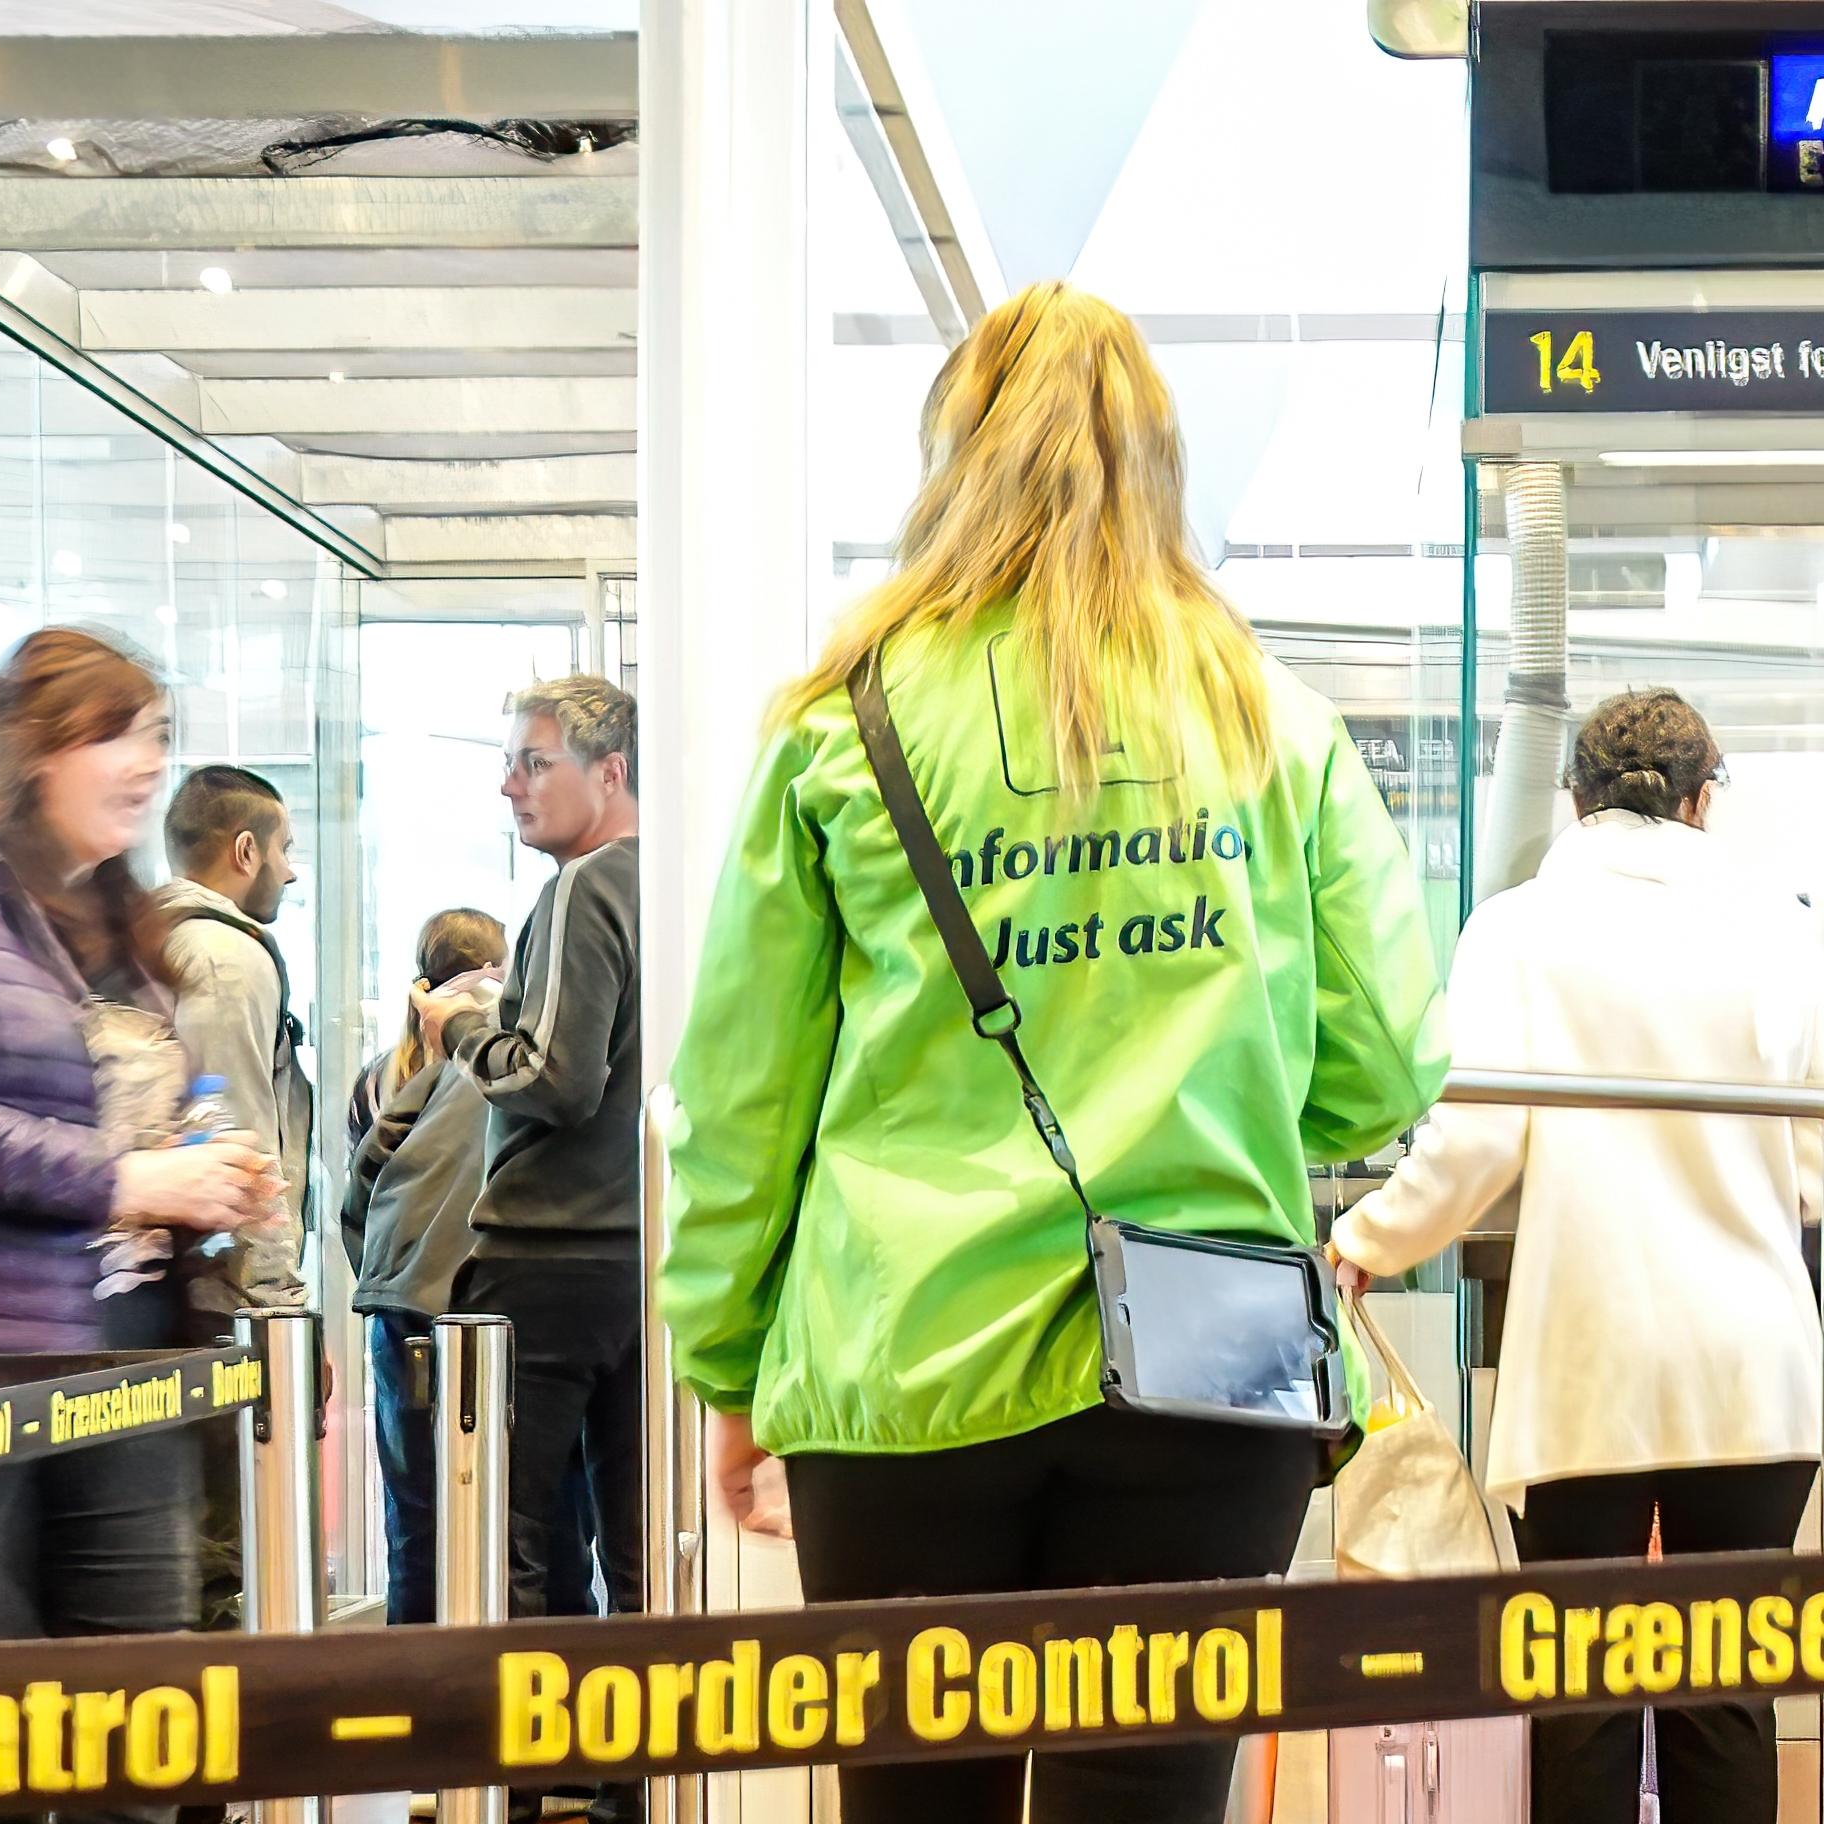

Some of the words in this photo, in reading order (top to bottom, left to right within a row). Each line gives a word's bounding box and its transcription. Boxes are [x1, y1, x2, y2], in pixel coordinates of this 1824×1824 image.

[1529, 330, 1602, 394] 14
[1635, 339, 1785, 387] Venligst
[948, 806, 1252, 888] nformatio
[991, 911, 1104, 970] Just
[1117, 894, 1227, 956] ask
[50, 1368, 182, 1445] Grænsekontrol
[497, 1636, 882, 1768] Border
[905, 1606, 1285, 1743] Control
